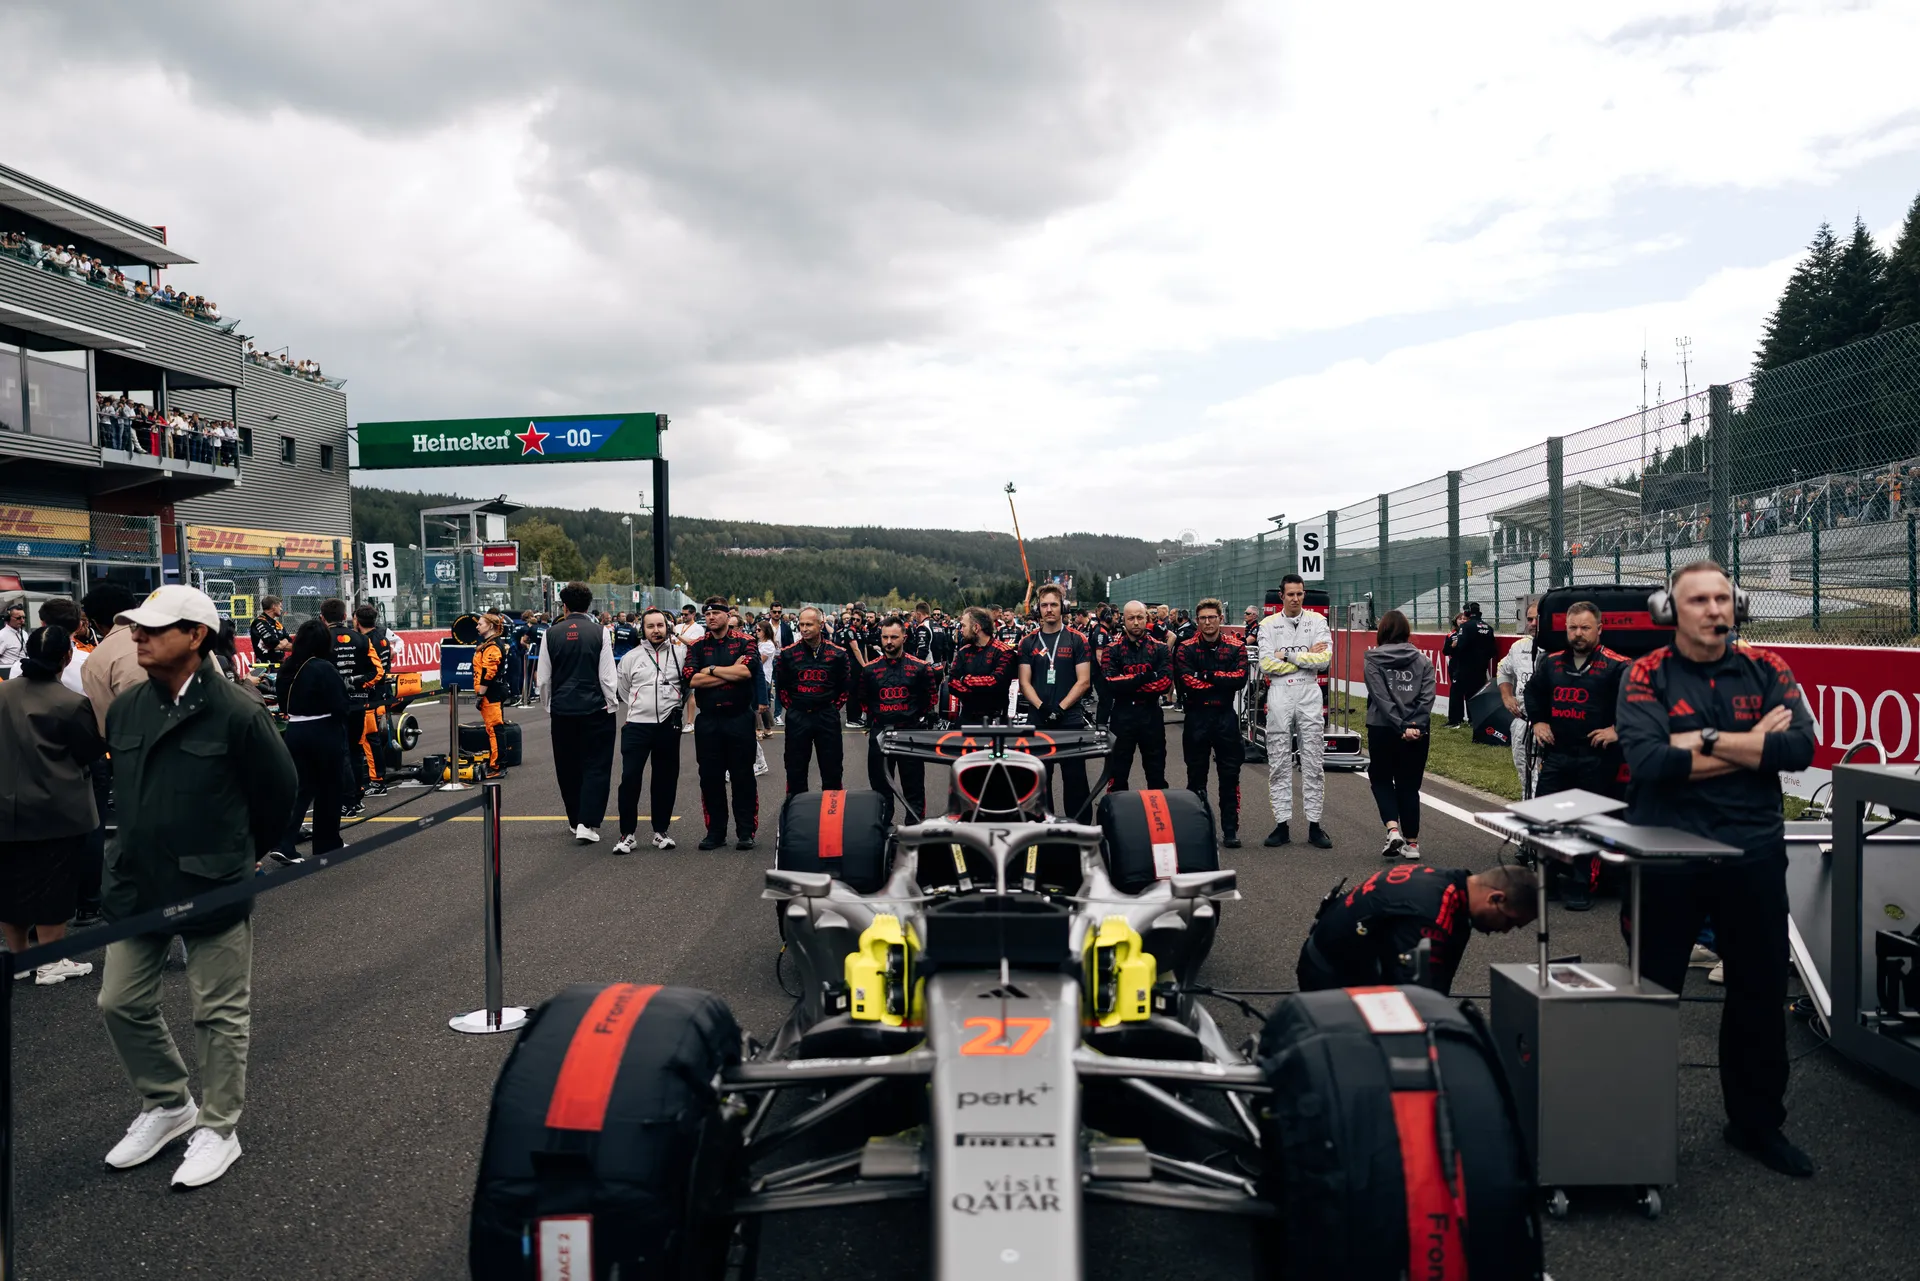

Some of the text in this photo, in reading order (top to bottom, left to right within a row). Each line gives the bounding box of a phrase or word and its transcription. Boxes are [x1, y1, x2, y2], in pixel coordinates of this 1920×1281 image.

[197, 530, 251, 550] DHL
[285, 537, 328, 554] DHL
[1612, 616, 1635, 626] Left
[391, 641, 440, 668] HANDO
[959, 1016, 1051, 1056] 27
[954, 1132, 1056, 1148] PIRELLI
[984, 1174, 1060, 1192] visit
[951, 1193, 1061, 1215] QATAR
